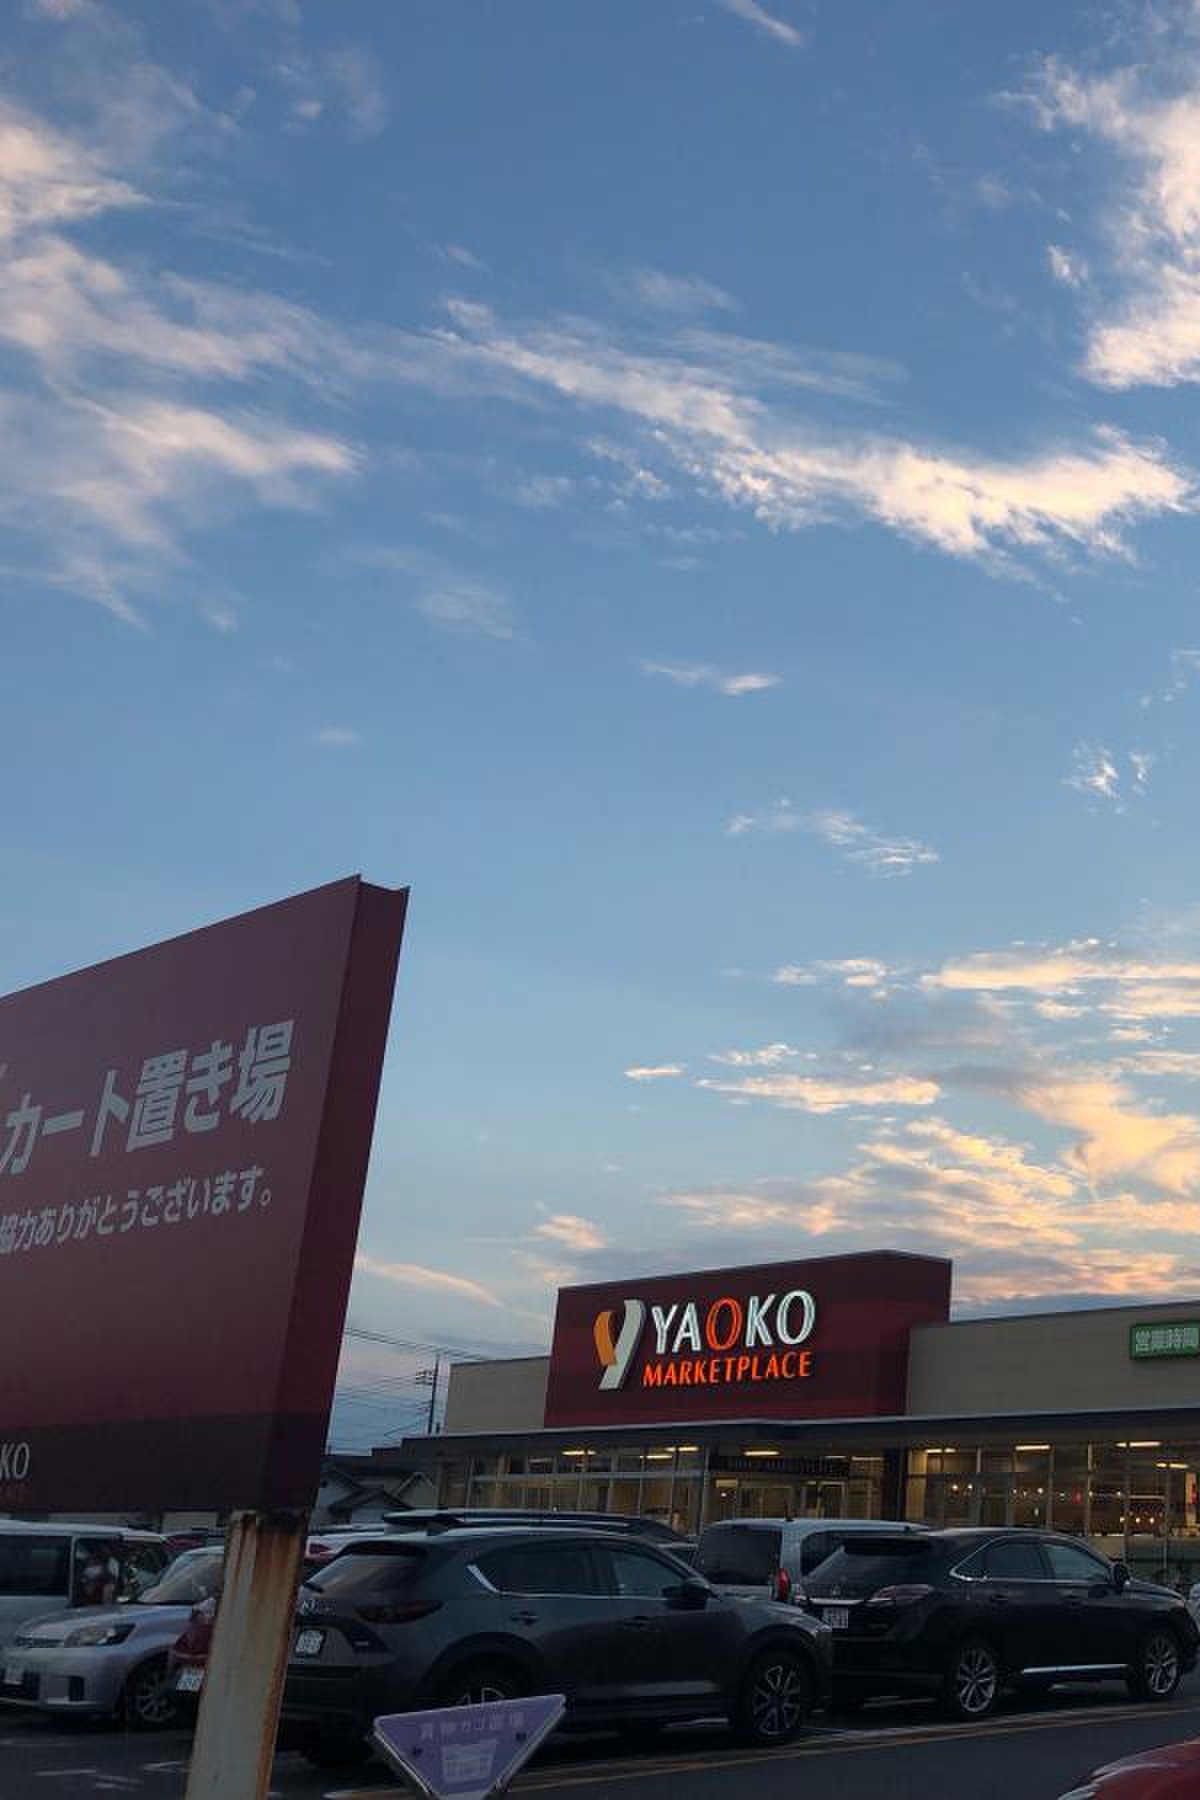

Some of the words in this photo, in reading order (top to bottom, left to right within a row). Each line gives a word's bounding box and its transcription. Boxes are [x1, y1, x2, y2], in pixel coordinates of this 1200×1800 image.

[0, 1020, 294, 1174] カート置き場
[651, 1290, 815, 1354] YAOKO
[643, 1350, 813, 1386] MARKETPLACE
